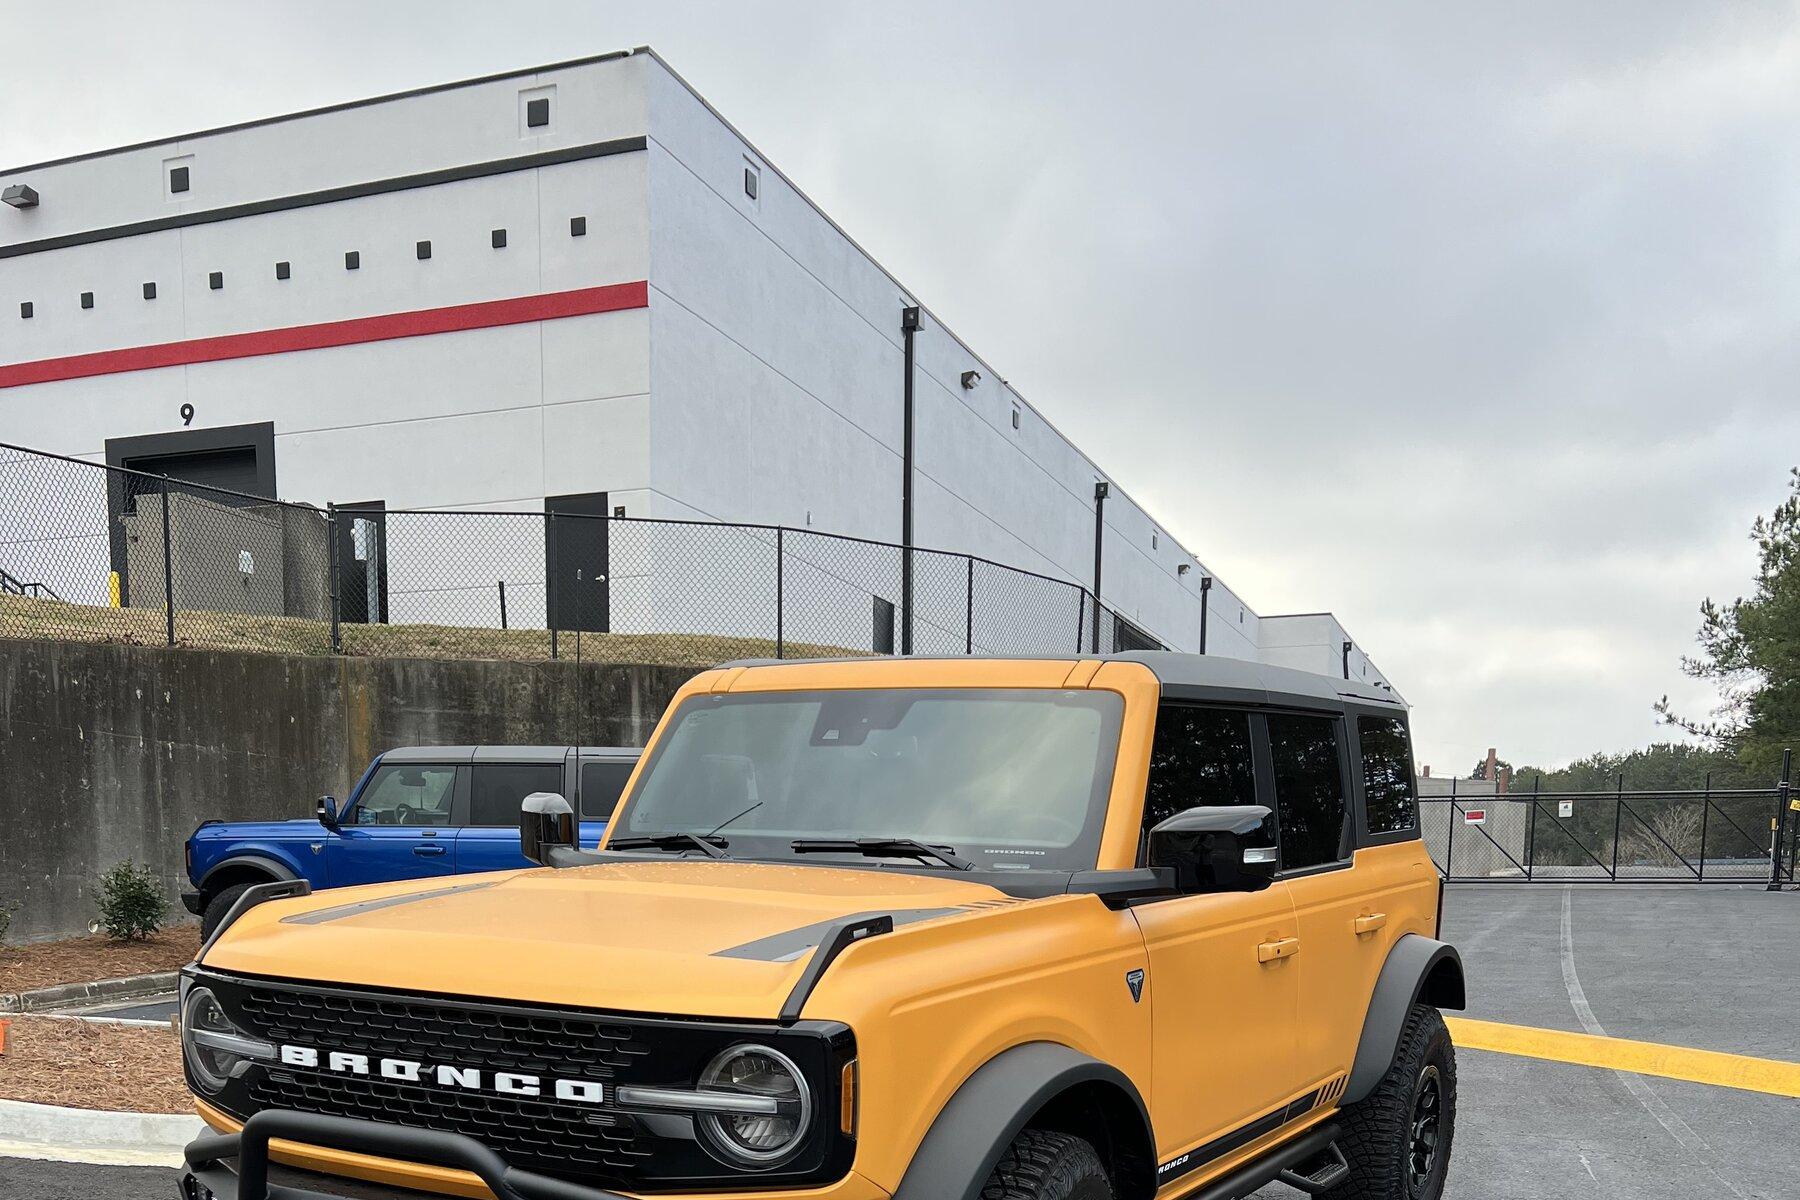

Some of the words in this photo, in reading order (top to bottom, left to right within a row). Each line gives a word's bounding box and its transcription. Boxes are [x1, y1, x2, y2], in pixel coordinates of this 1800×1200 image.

[180, 403, 195, 426] 9
[281, 1045, 604, 1104] BRONCO
[1158, 1154, 1190, 1174] RONCO
